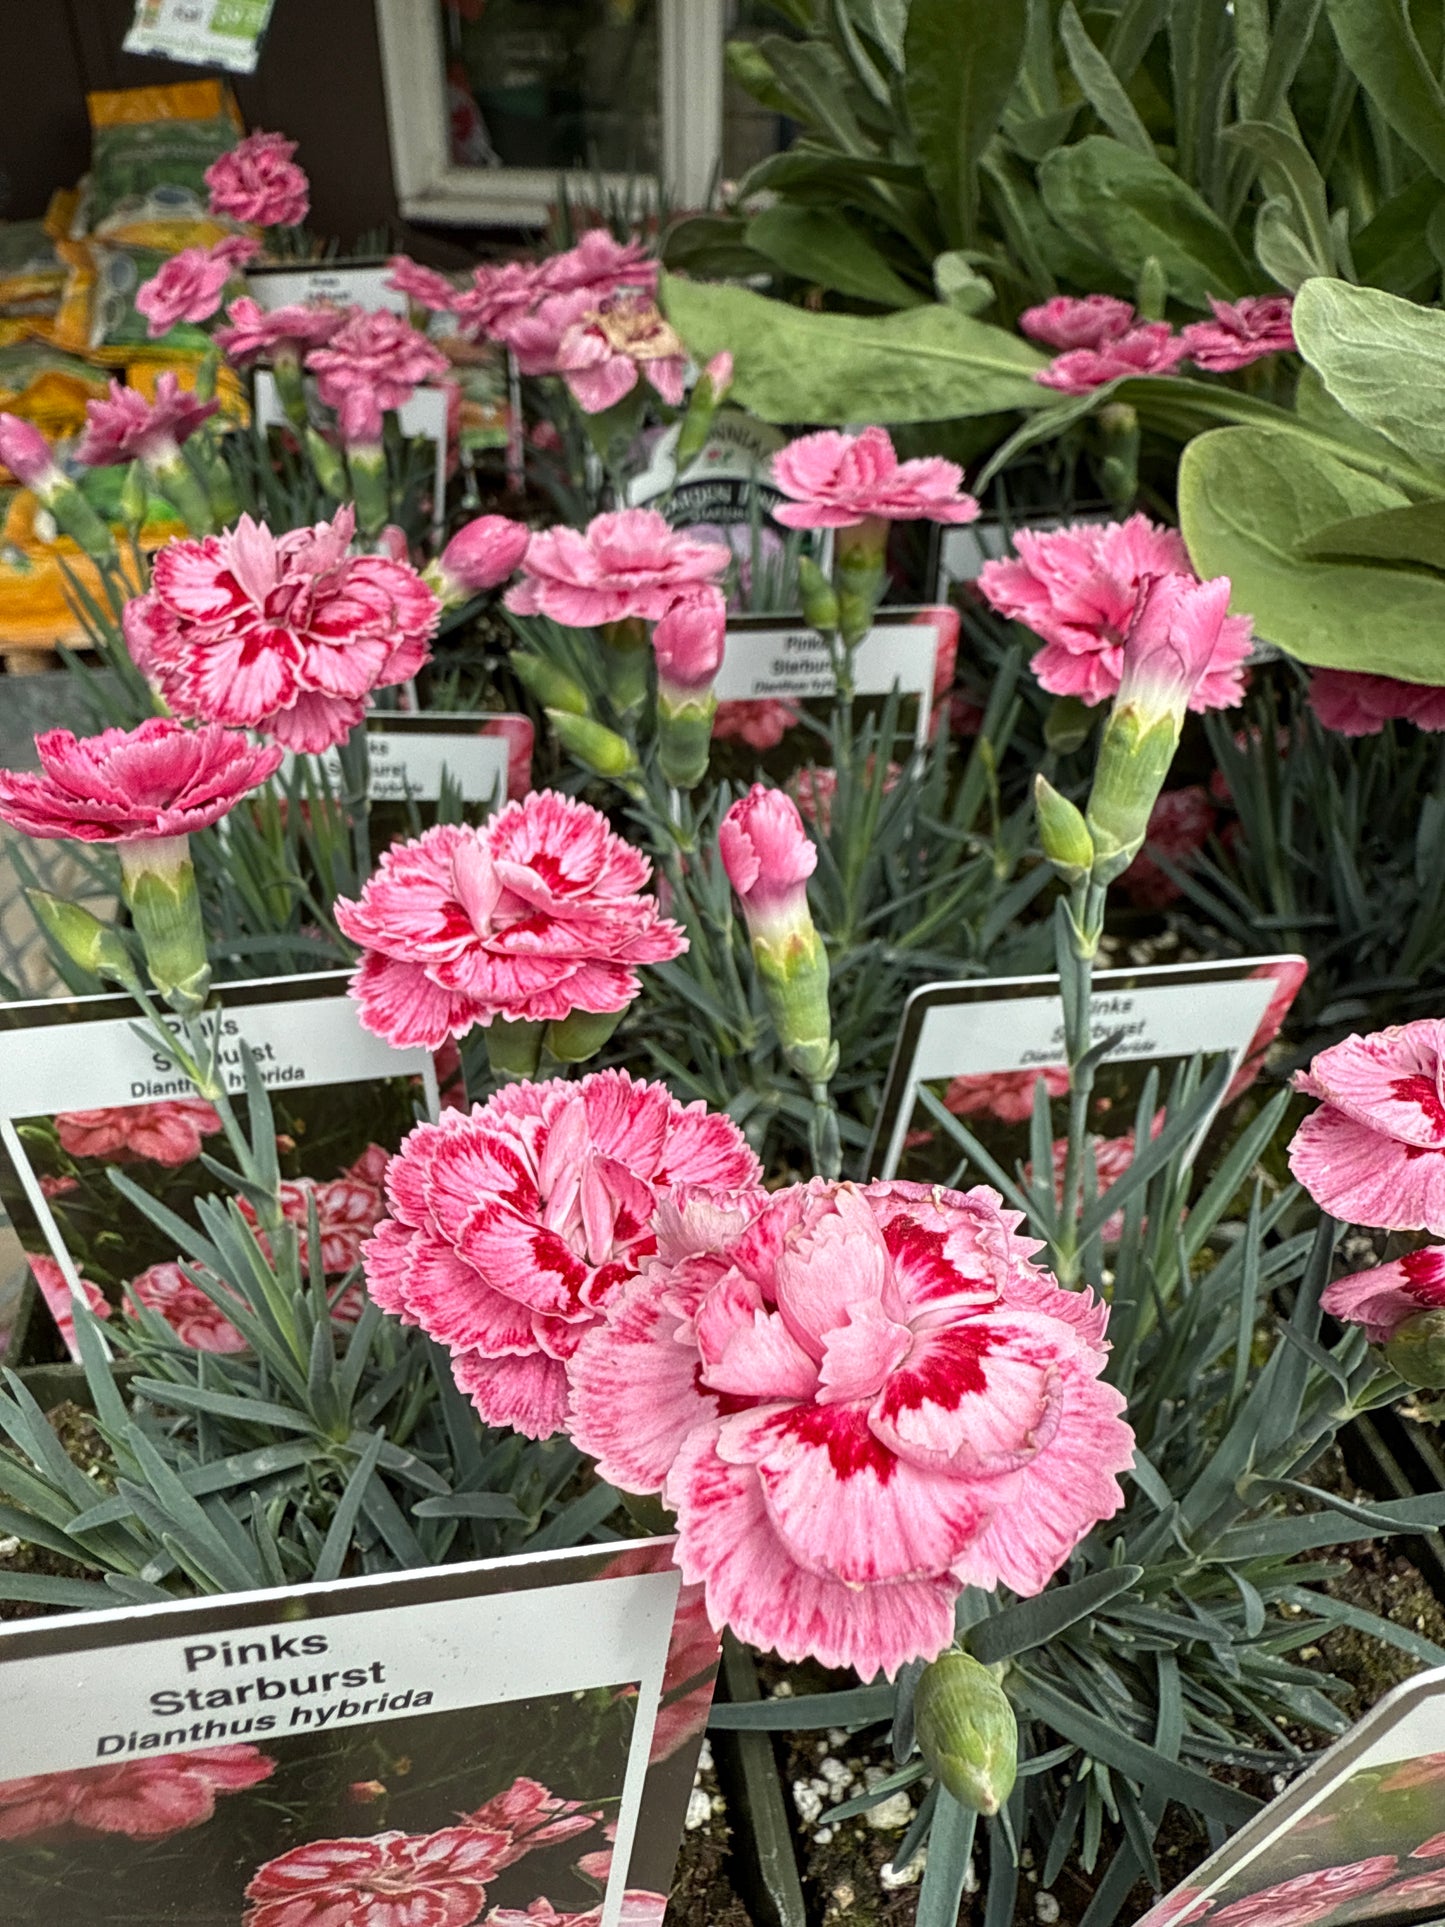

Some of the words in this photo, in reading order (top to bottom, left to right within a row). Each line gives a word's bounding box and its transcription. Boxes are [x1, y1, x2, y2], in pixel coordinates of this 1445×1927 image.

[183, 1634, 329, 1673] Pinks
[149, 1661, 386, 1716] Starburst
[96, 1715, 277, 1757] Dianthus
[289, 1689, 434, 1728] hybrida
